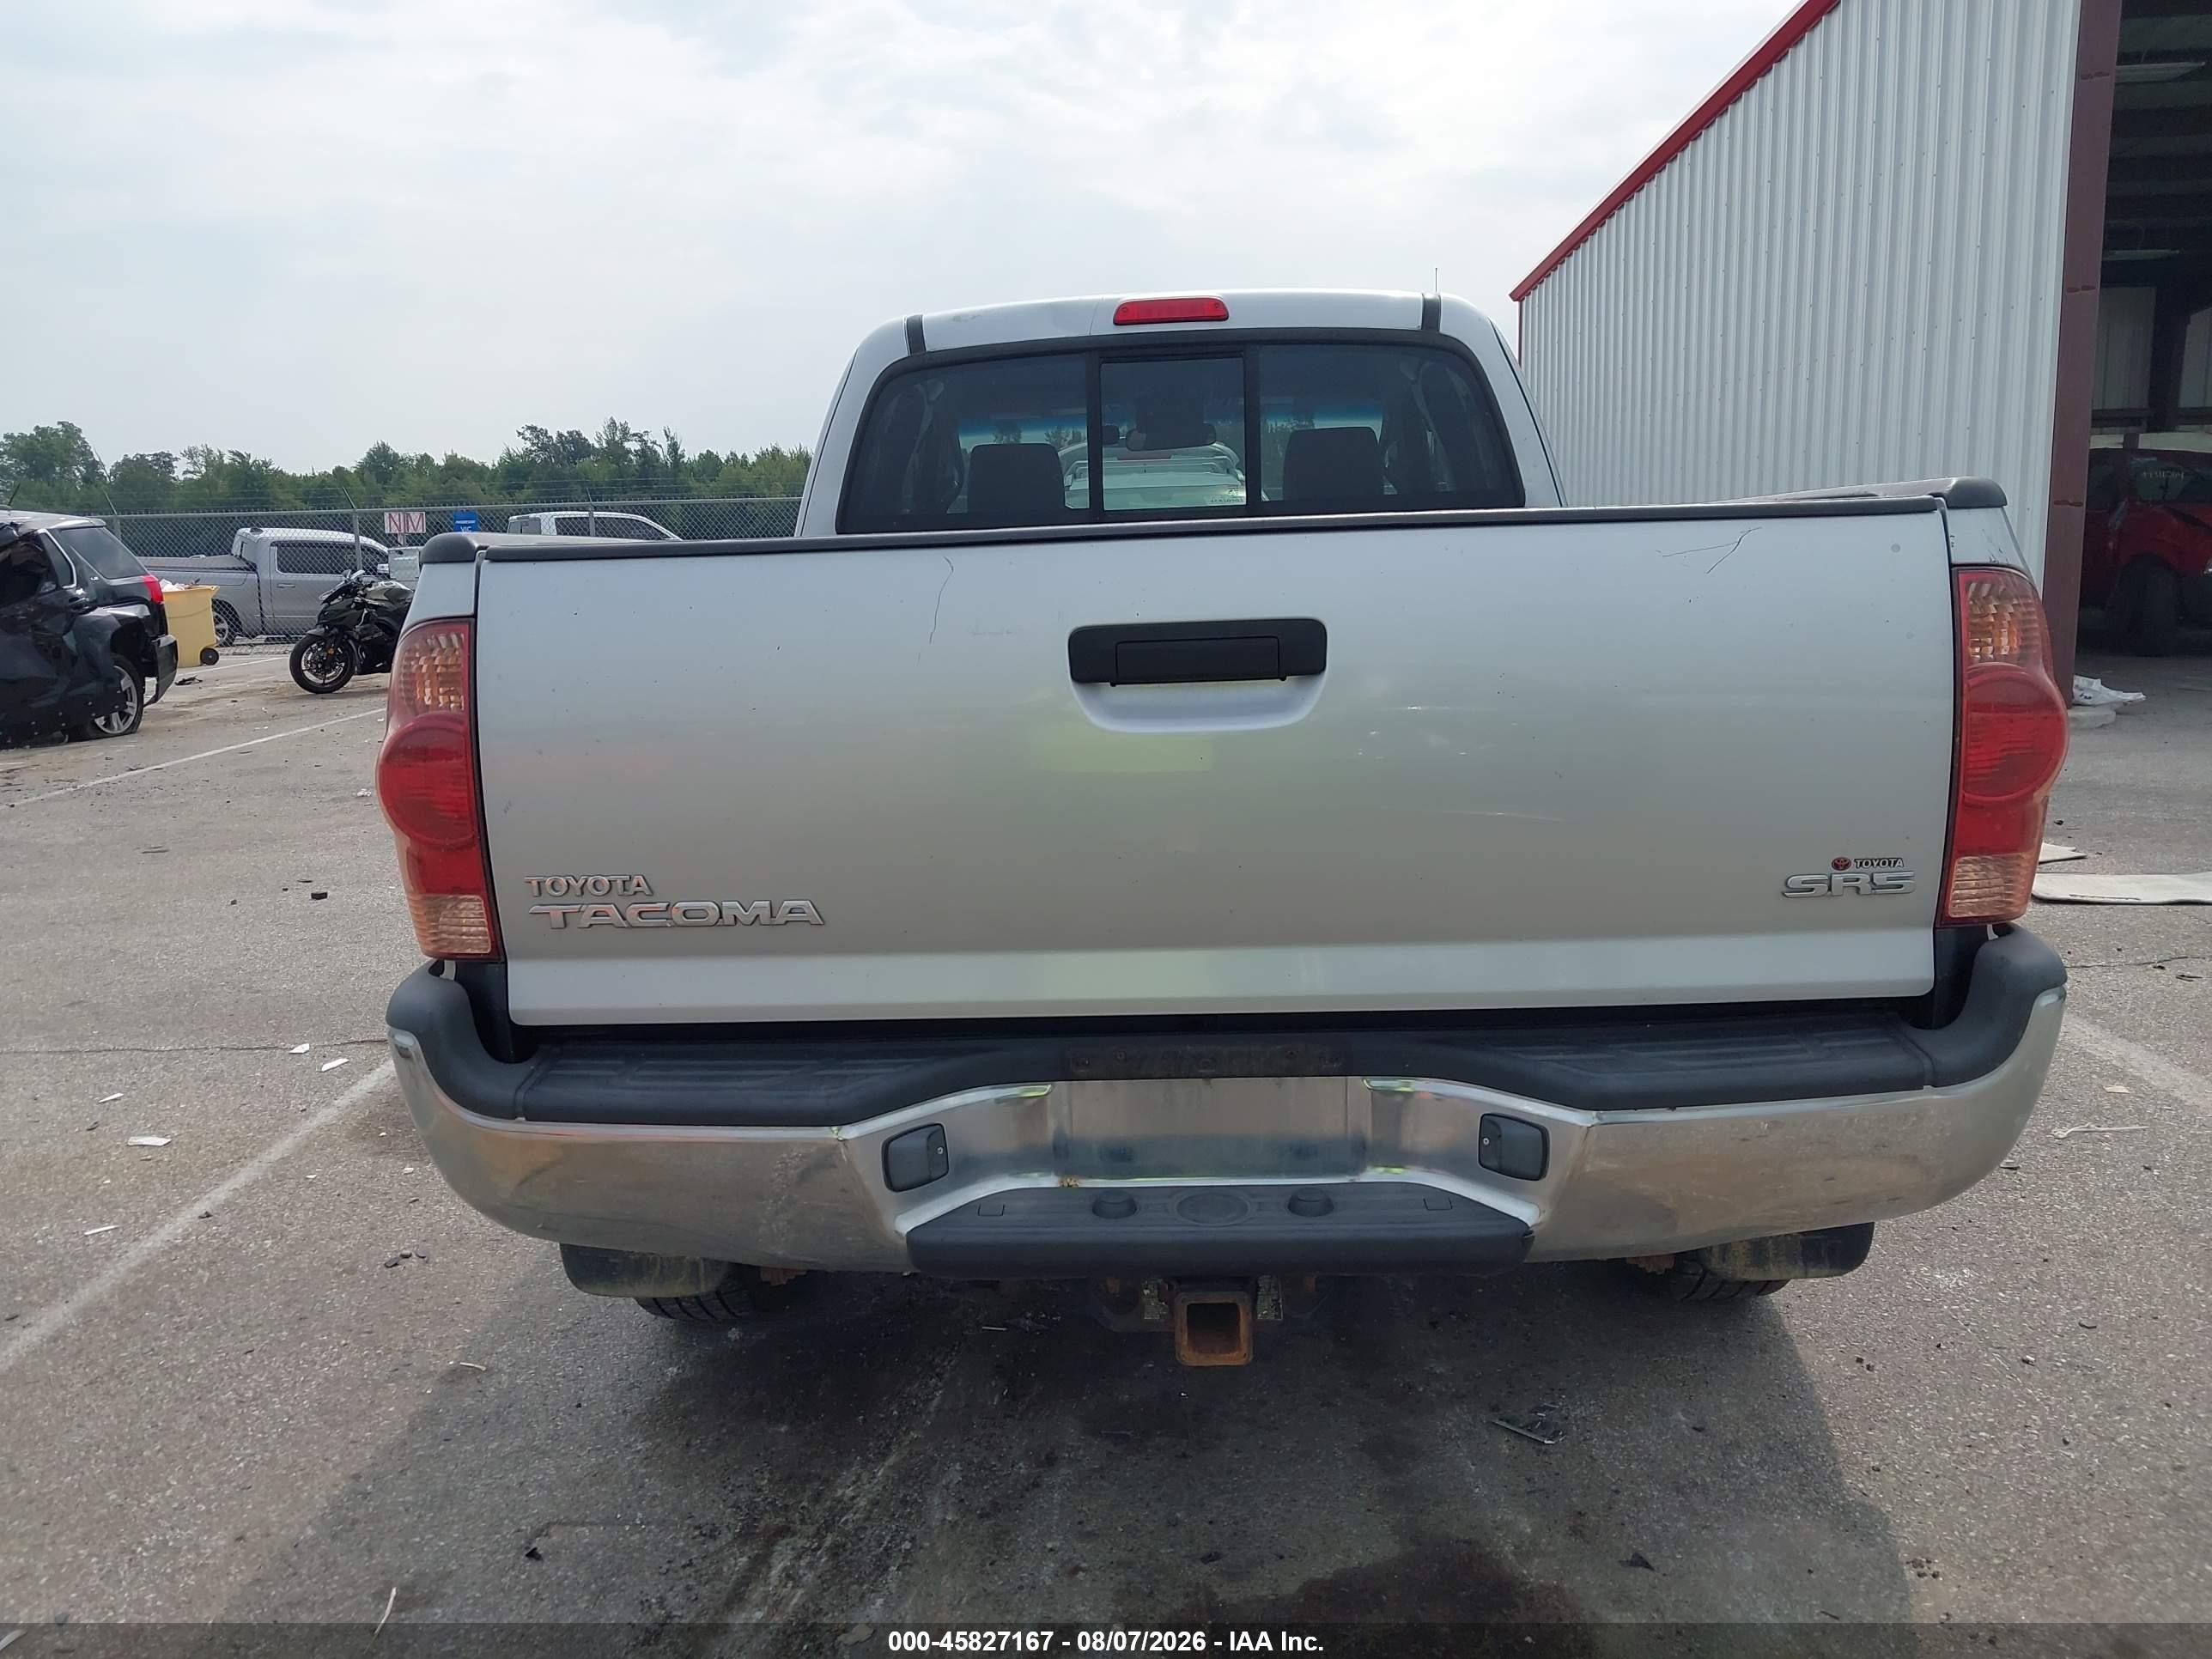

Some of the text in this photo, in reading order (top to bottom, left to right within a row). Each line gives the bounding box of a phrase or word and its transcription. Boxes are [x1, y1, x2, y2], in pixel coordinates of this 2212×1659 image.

[1854, 857, 1905, 869] TOYOTA
[525, 875, 653, 897] TOYOTA
[1782, 871, 1917, 898] SR5
[529, 900, 825, 929] TACOMA
